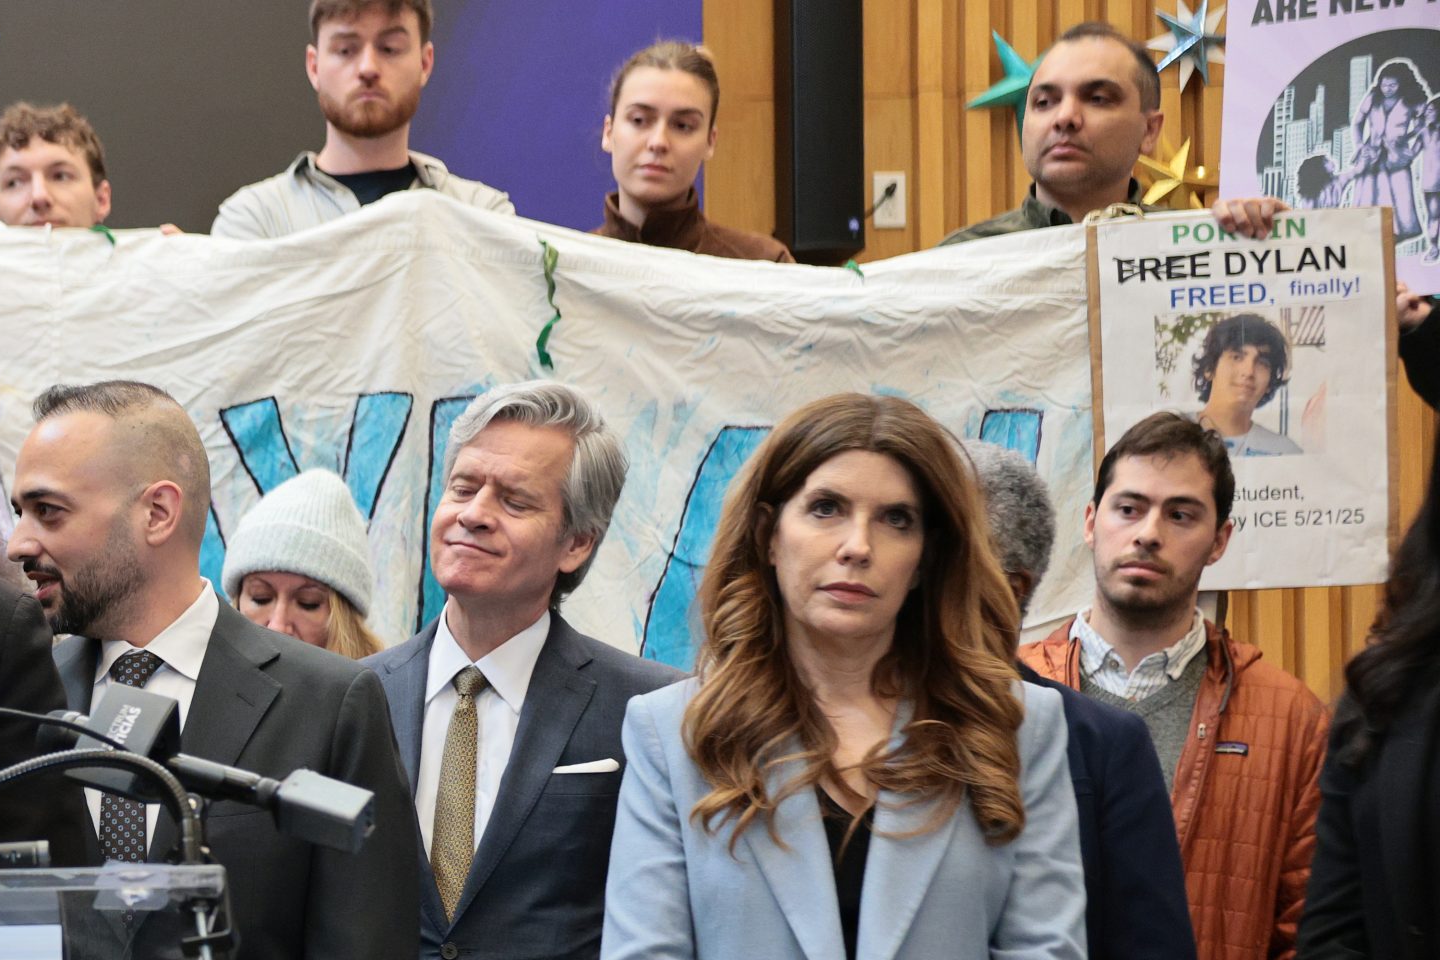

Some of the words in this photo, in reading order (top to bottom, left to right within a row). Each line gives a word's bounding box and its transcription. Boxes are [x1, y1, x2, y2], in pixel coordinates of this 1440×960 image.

[1115, 251, 1211, 285] FREE
[1224, 245, 1347, 277] DYLAN
[1170, 283, 1275, 309] FREED,
[1289, 277, 1361, 298] finally!
[1234, 485, 1304, 501] student,
[1254, 511, 1287, 528] ICE
[1294, 508, 1365, 527] 5/21/25
